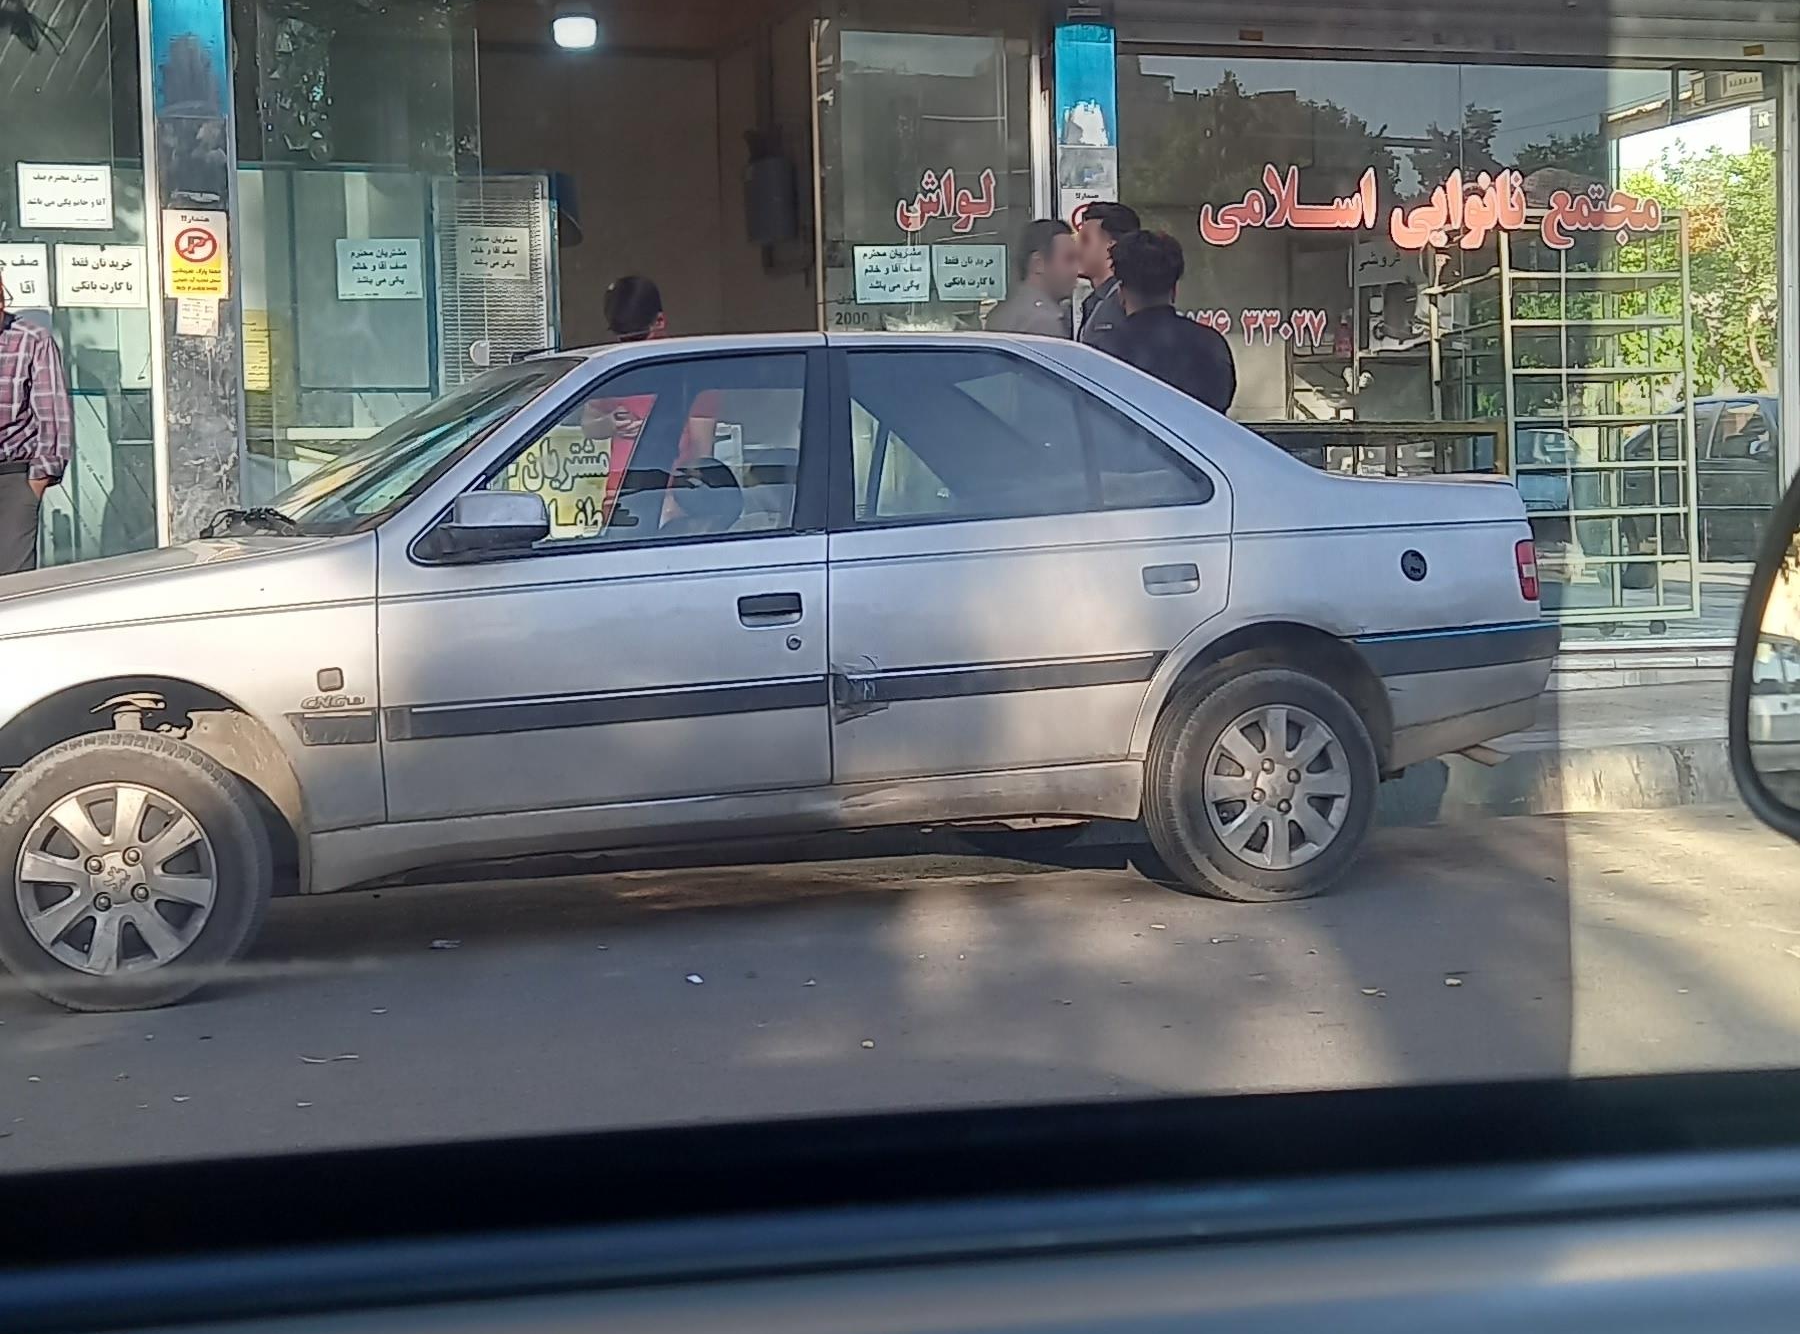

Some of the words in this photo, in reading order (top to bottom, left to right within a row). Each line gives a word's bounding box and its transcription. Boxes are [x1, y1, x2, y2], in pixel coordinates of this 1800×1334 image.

[48, 174, 70, 183] محترم
[71, 174, 99, 183] مشتریان
[896, 168, 996, 233] لواش
[1200, 164, 1378, 247] اسلامی
[1390, 169, 1527, 250] نانوایی
[1541, 184, 1661, 249] مجتمع
[350, 250, 374, 259] محترم
[375, 248, 408, 259] مشتریان
[862, 248, 887, 259] محترم
[889, 247, 922, 259] مشتریان
[11, 254, 39, 266] صف
[71, 257, 89, 267] فقط
[91, 257, 107, 270] نان
[109, 258, 133, 271] خرید
[944, 255, 959, 265] فقط
[864, 264, 882, 275] خانم
[20, 280, 35, 293] آقا
[71, 280, 98, 293] بانکی
[99, 281, 124, 294] کارت
[124, 281, 133, 293] با
[889, 282, 901, 292] می
[903, 280, 920, 292] یکی
[944, 276, 966, 288] بانکی
[967, 276, 989, 289] کارت
[1241, 310, 1327, 347] ۳۳۰۲۷
[301, 695, 346, 709] CNG
